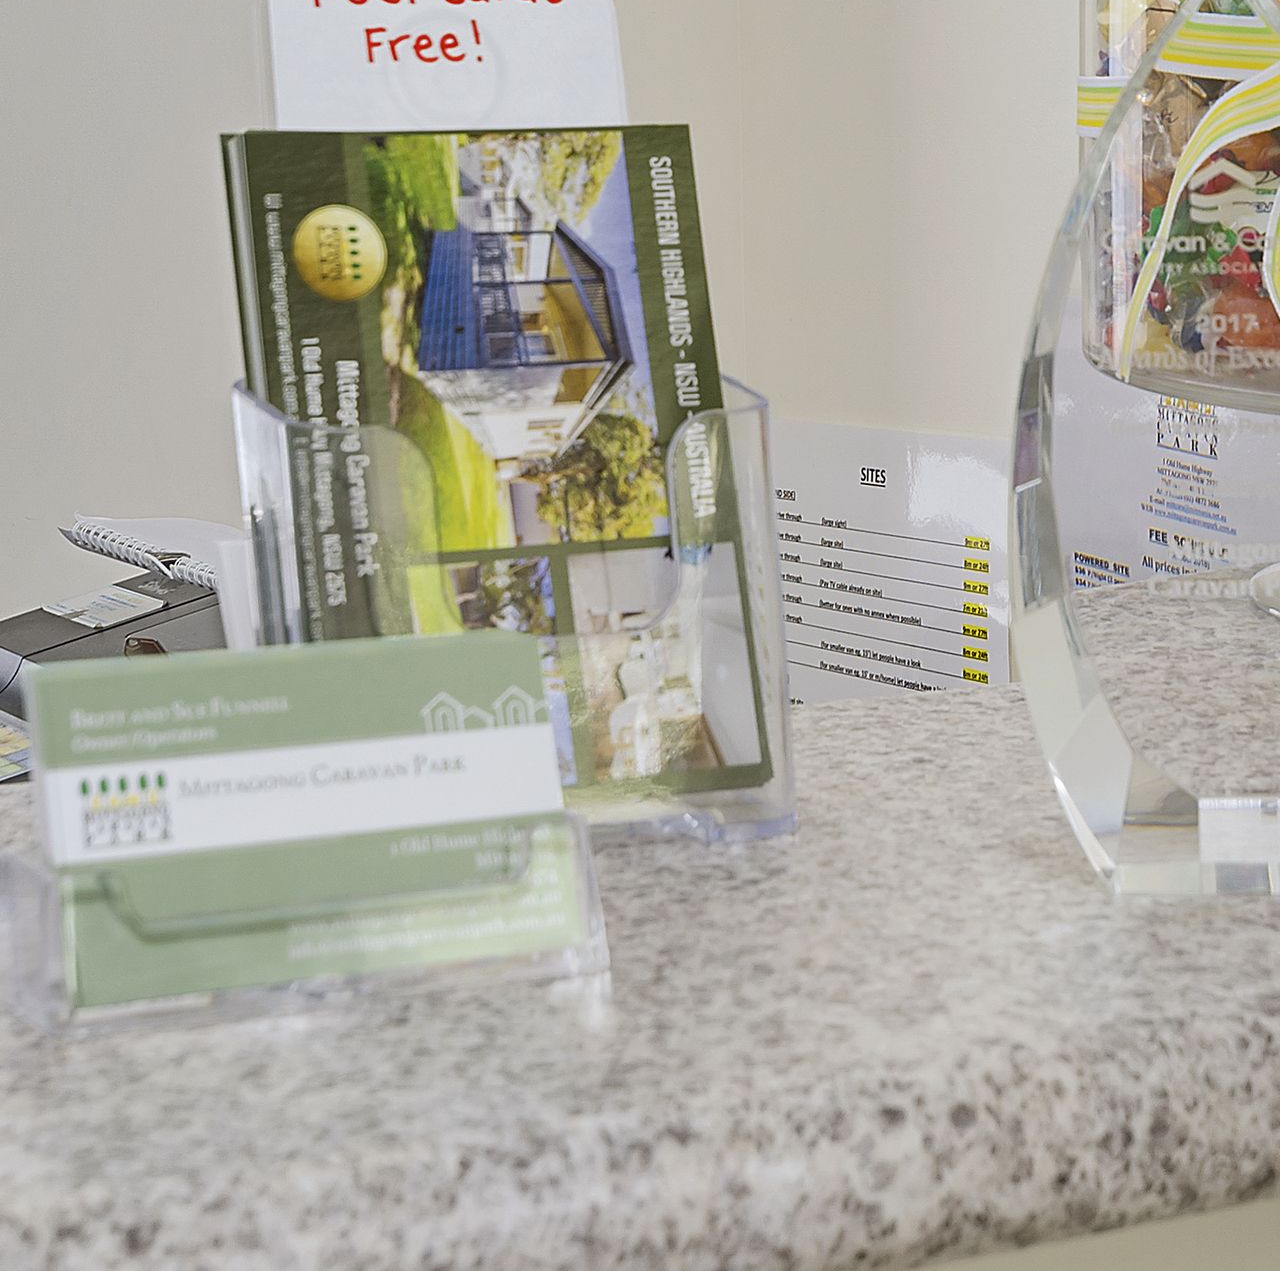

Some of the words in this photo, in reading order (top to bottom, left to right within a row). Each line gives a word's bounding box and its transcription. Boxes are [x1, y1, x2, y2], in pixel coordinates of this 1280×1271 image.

[364, 19, 483, 64] Free!
[649, 156, 680, 246] SOUTHERN
[265, 211, 300, 422] www.mittagongcaravanpark.com.a
[660, 249, 693, 348] HIGHLANDS
[301, 346, 322, 373] Old
[304, 373, 324, 416] Hume
[335, 359, 362, 452] Mittagong
[673, 362, 701, 408] NSW
[345, 454, 370, 529] Caravan
[682, 420, 717, 519] AUSTRALIA
[860, 468, 886, 485] SITES
[322, 533, 345, 570] NSW
[354, 532, 381, 578] Park
[1149, 528, 1169, 544] FEE
[1142, 555, 1154, 569] All
[1154, 561, 1181, 576] prices
